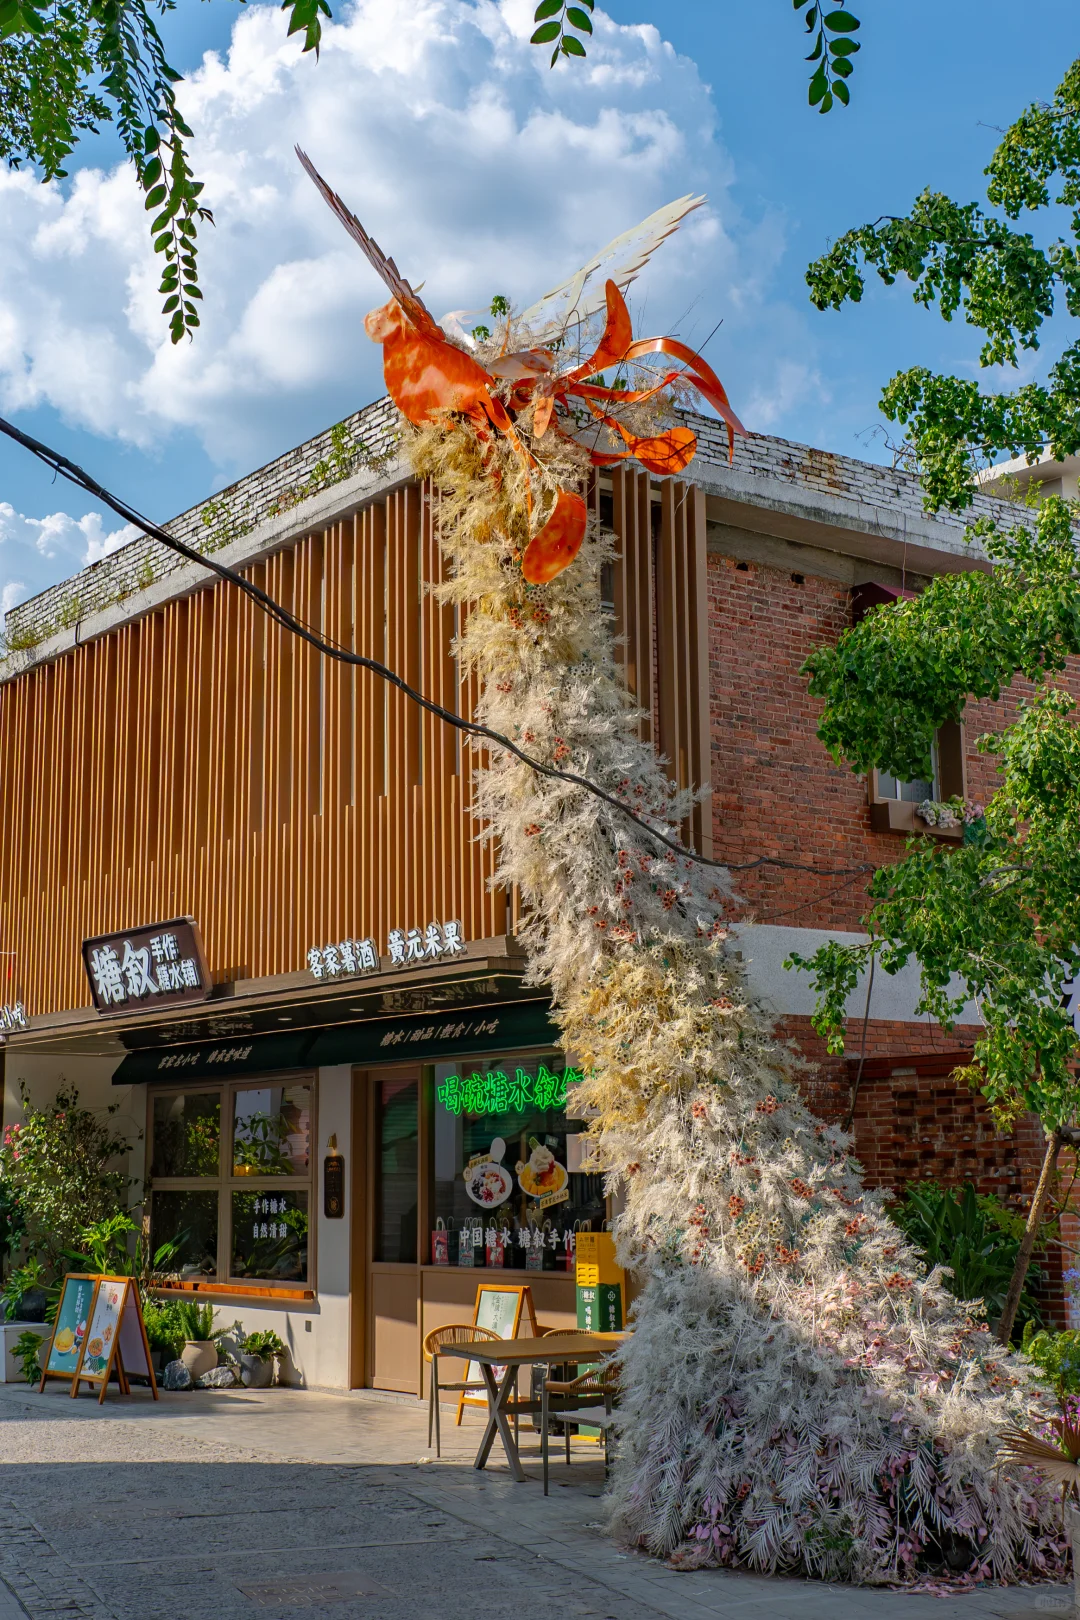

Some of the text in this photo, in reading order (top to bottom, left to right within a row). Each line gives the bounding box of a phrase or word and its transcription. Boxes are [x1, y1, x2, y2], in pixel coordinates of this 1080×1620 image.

[150, 932, 179, 963] 手作
[307, 939, 377, 979] 客家薯酒
[91, 939, 161, 1005] 糖叙
[253, 1197, 287, 1215] 手作糖水
[253, 1222, 288, 1239] 自然清甜
[459, 1226, 513, 1249] 中国糖水
[518, 1227, 576, 1251] 糖叙手作
